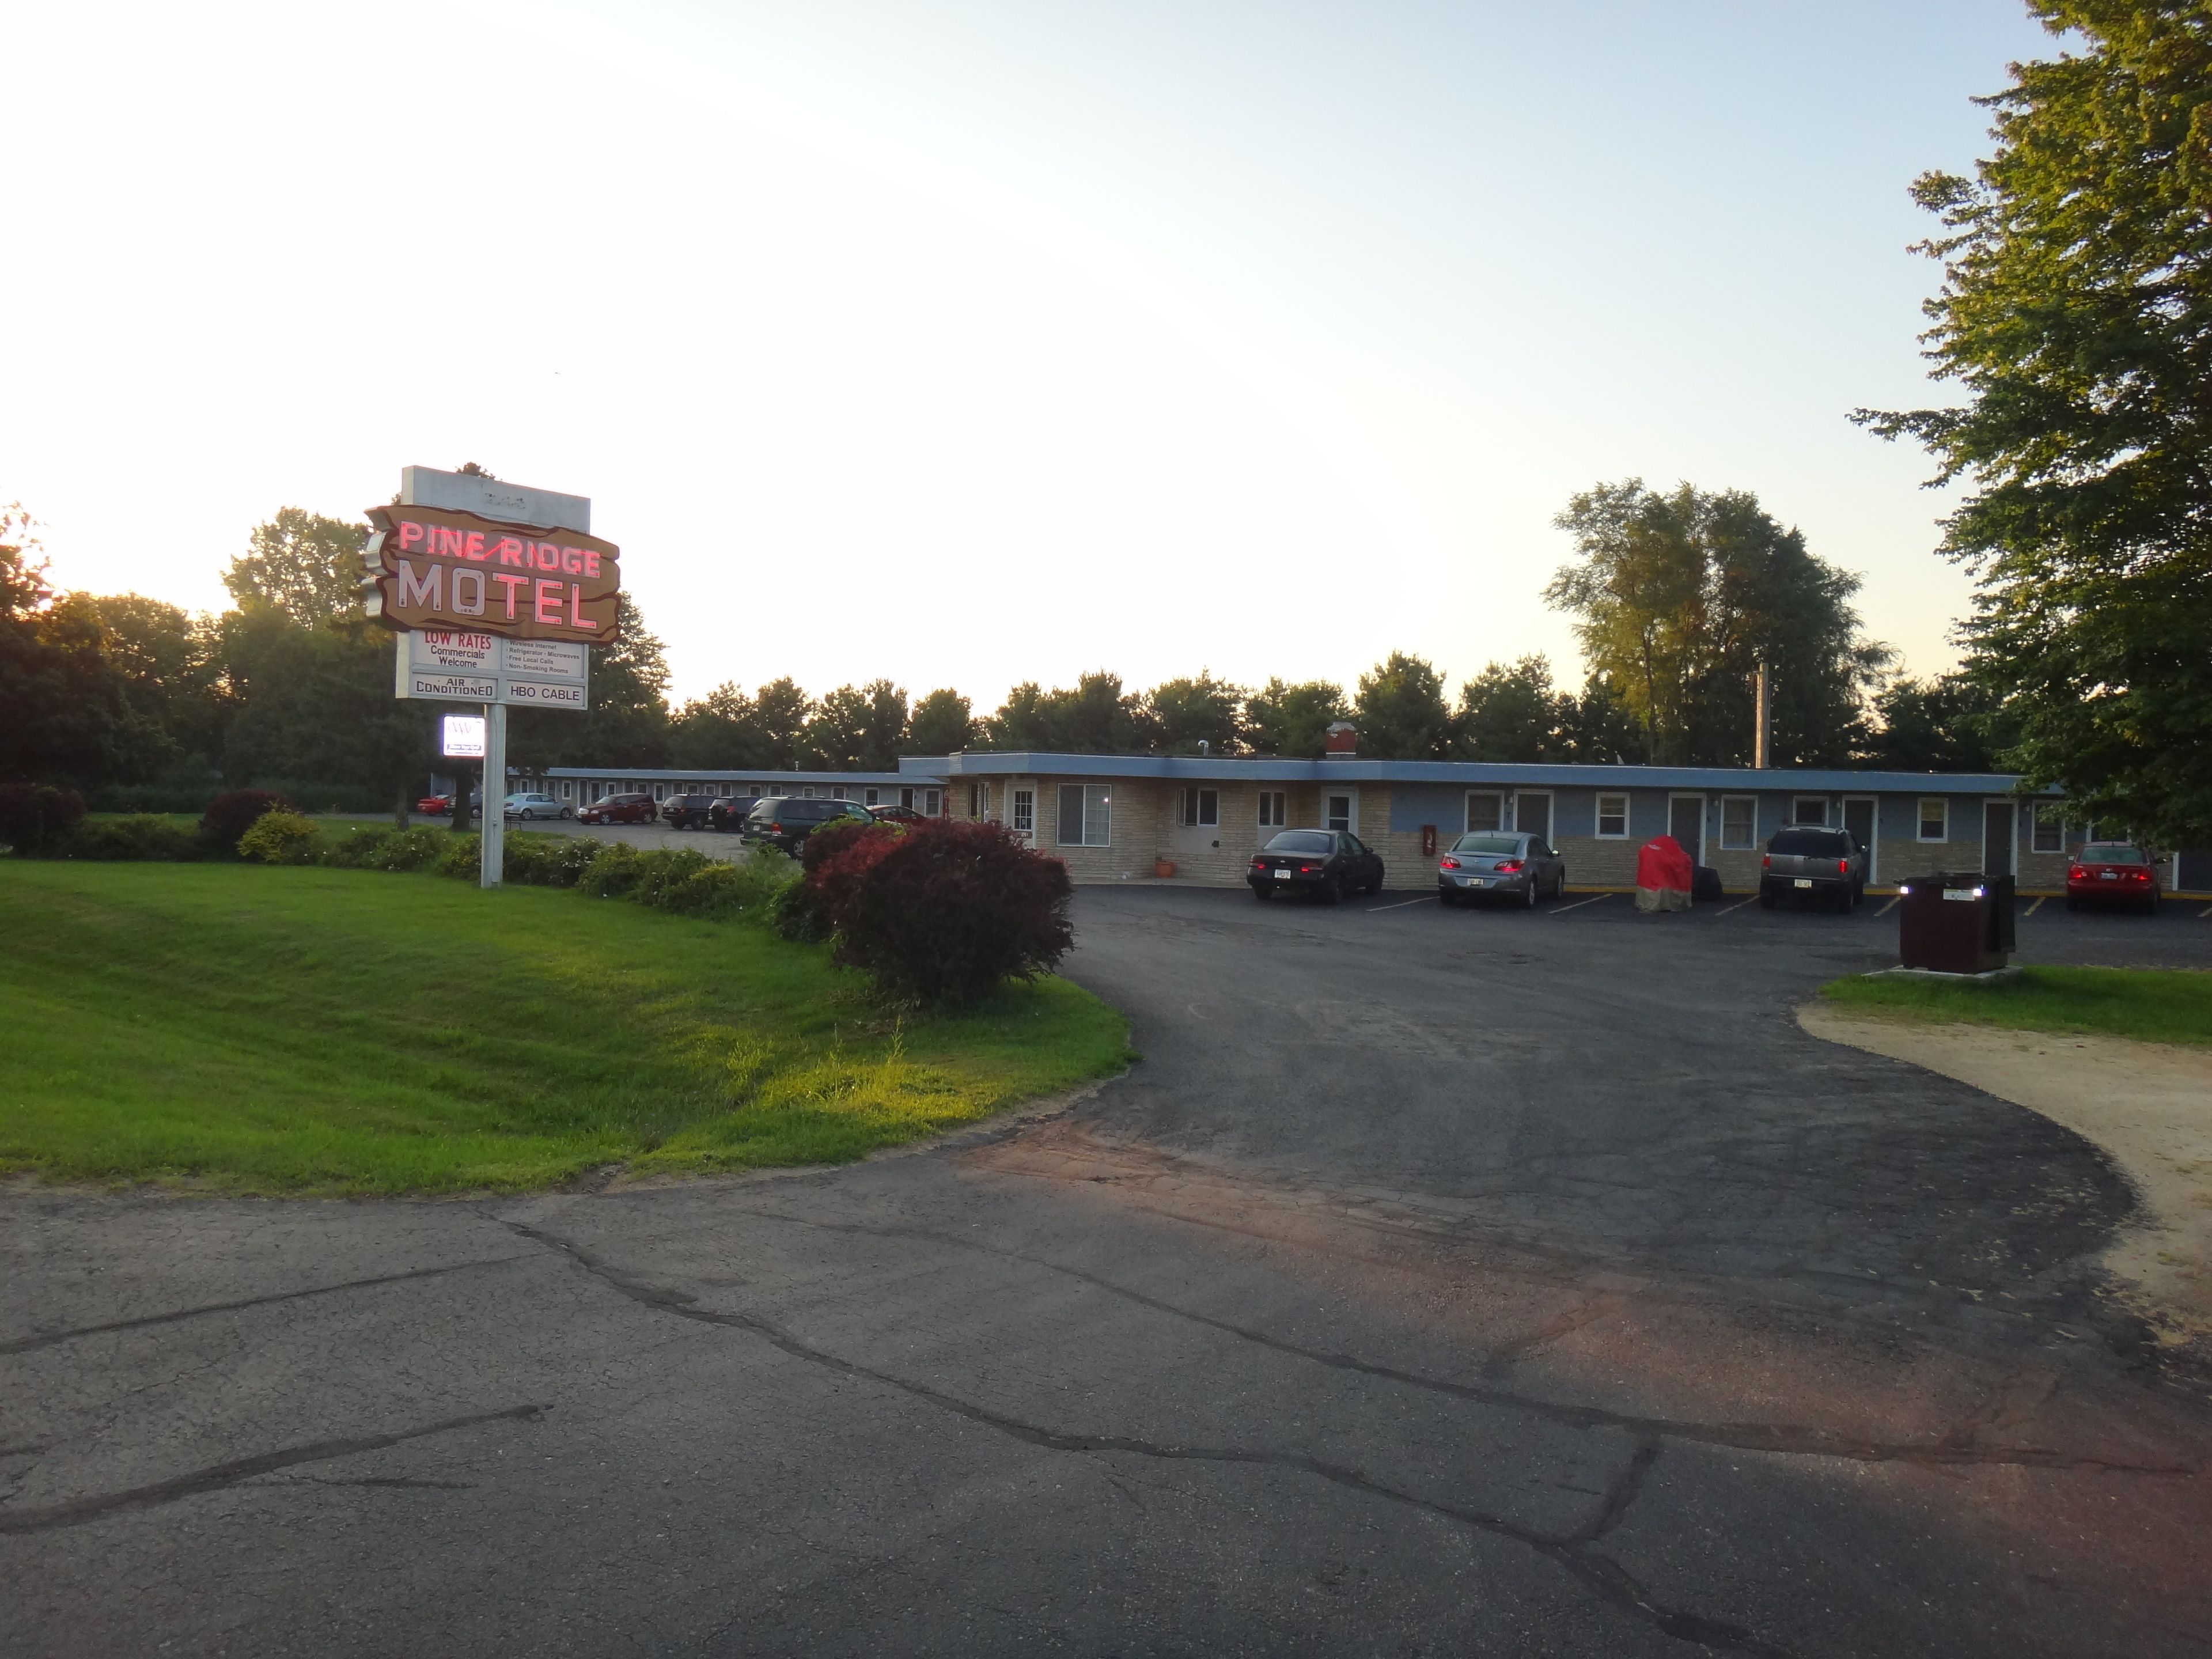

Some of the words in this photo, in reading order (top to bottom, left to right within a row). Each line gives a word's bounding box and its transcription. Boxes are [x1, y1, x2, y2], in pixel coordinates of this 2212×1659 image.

[400, 521, 485, 561] PINE
[500, 536, 600, 579] RIDGE
[398, 559, 597, 630] MOTEL
[425, 631, 452, 645] LOW
[458, 634, 491, 650] RATES
[431, 645, 485, 659] Commercials
[509, 647, 543, 656] Refrigerator
[547, 652, 579, 660] Microwaves
[439, 656, 478, 668] Welcome
[509, 663, 548, 673] Non-Smoking
[416, 681, 493, 696] CONDITIONED
[446, 678, 465, 687] AIR
[510, 685, 536, 698] HBO
[541, 688, 579, 700] CABLE
